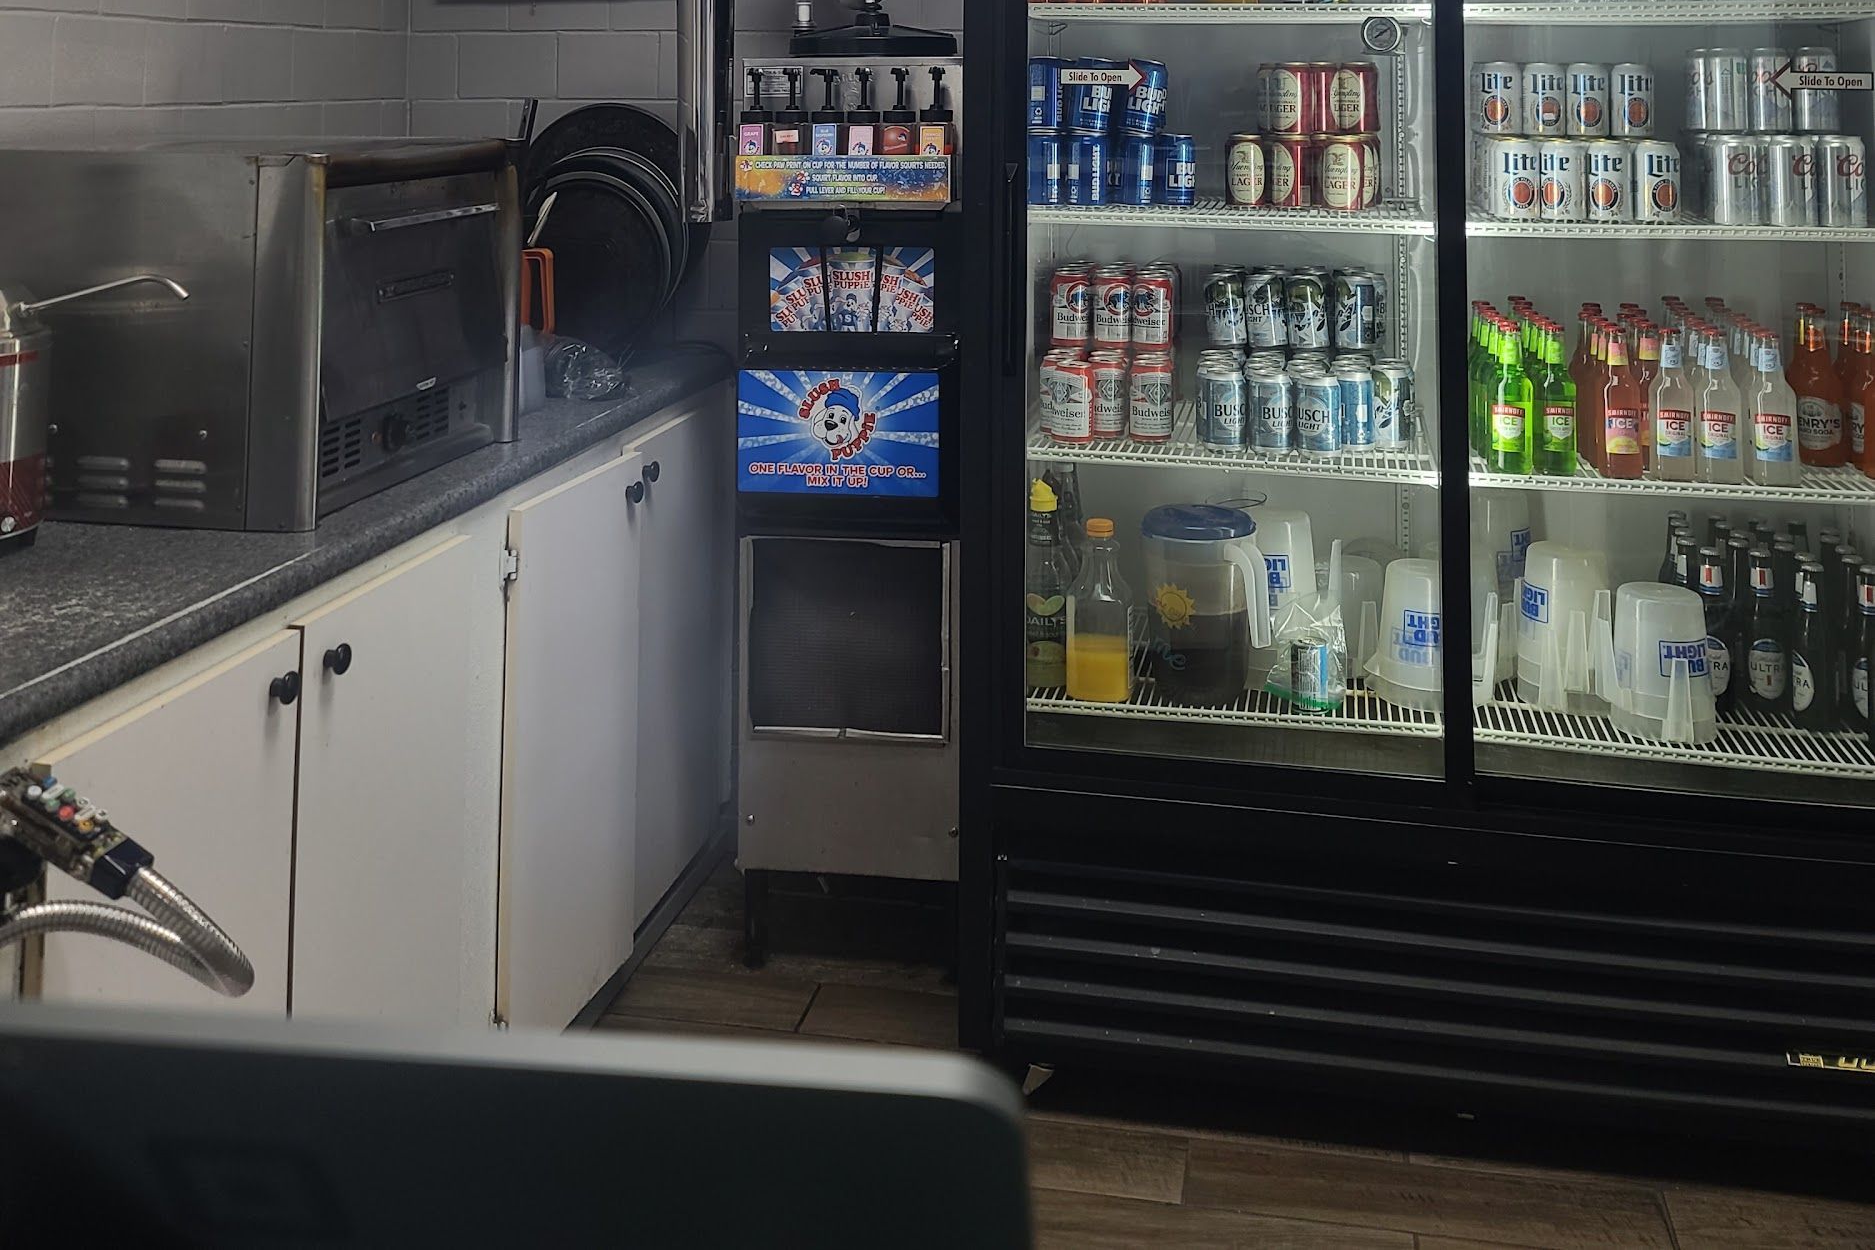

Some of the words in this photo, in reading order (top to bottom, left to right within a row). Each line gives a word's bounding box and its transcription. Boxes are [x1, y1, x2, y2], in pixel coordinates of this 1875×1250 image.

[1069, 72, 1088, 81] Slide
[1090, 73, 1098, 81] To
[1101, 73, 1122, 84] Open
[1481, 73, 1512, 94] Lite
[1800, 76, 1821, 85] Slide
[1825, 76, 1834, 85] To
[1838, 76, 1862, 88] Open
[1532, 74, 1563, 95] Lite
[1572, 74, 1605, 95] Lite
[755, 161, 773, 169] CHECK
[787, 161, 802, 169] PRINT
[803, 161, 811, 169] ON
[812, 161, 823, 169] CUP
[824, 161, 835, 169] FOR
[836, 161, 846, 169] THE
[848, 161, 870, 169] NUMBER
[871, 161, 878, 169] OF
[879, 161, 899, 169] FLAVOR
[900, 161, 923, 170] SQUIRTS
[1503, 152, 1537, 175] Lite
[1540, 152, 1570, 175] Lite
[1588, 153, 1623, 176] Lite
[1647, 154, 1679, 177] Lite
[812, 174, 831, 182] SQUIRT
[832, 174, 852, 182] FLAVOR
[853, 174, 865, 182] INTO
[1231, 178, 1262, 186] LAGER
[806, 186, 818, 194] PULL
[819, 186, 834, 194] LEVER
[835, 186, 846, 194] AND
[847, 186, 856, 194] FILL
[833, 270, 870, 281] SLUSH
[799, 378, 840, 419] SLUSH
[1132, 406, 1171, 418] Budweis
[1660, 411, 1690, 420] SMIRNOFF
[1552, 417, 1570, 426] ICE
[1612, 418, 1633, 428] ICE
[1666, 422, 1685, 431] ICE
[1799, 417, 1840, 429] ENRY'S
[1708, 424, 1728, 433] ICE
[1764, 426, 1783, 435] ICE
[750, 463, 775, 474] ONE
[778, 464, 821, 474] FLAVOR
[826, 464, 838, 475] IN
[843, 465, 865, 476] THE
[869, 466, 892, 477] CUP
[897, 467, 926, 478] OR...
[807, 475, 829, 486] MIX
[832, 476, 844, 487] IT
[849, 476, 868, 487] UP!
